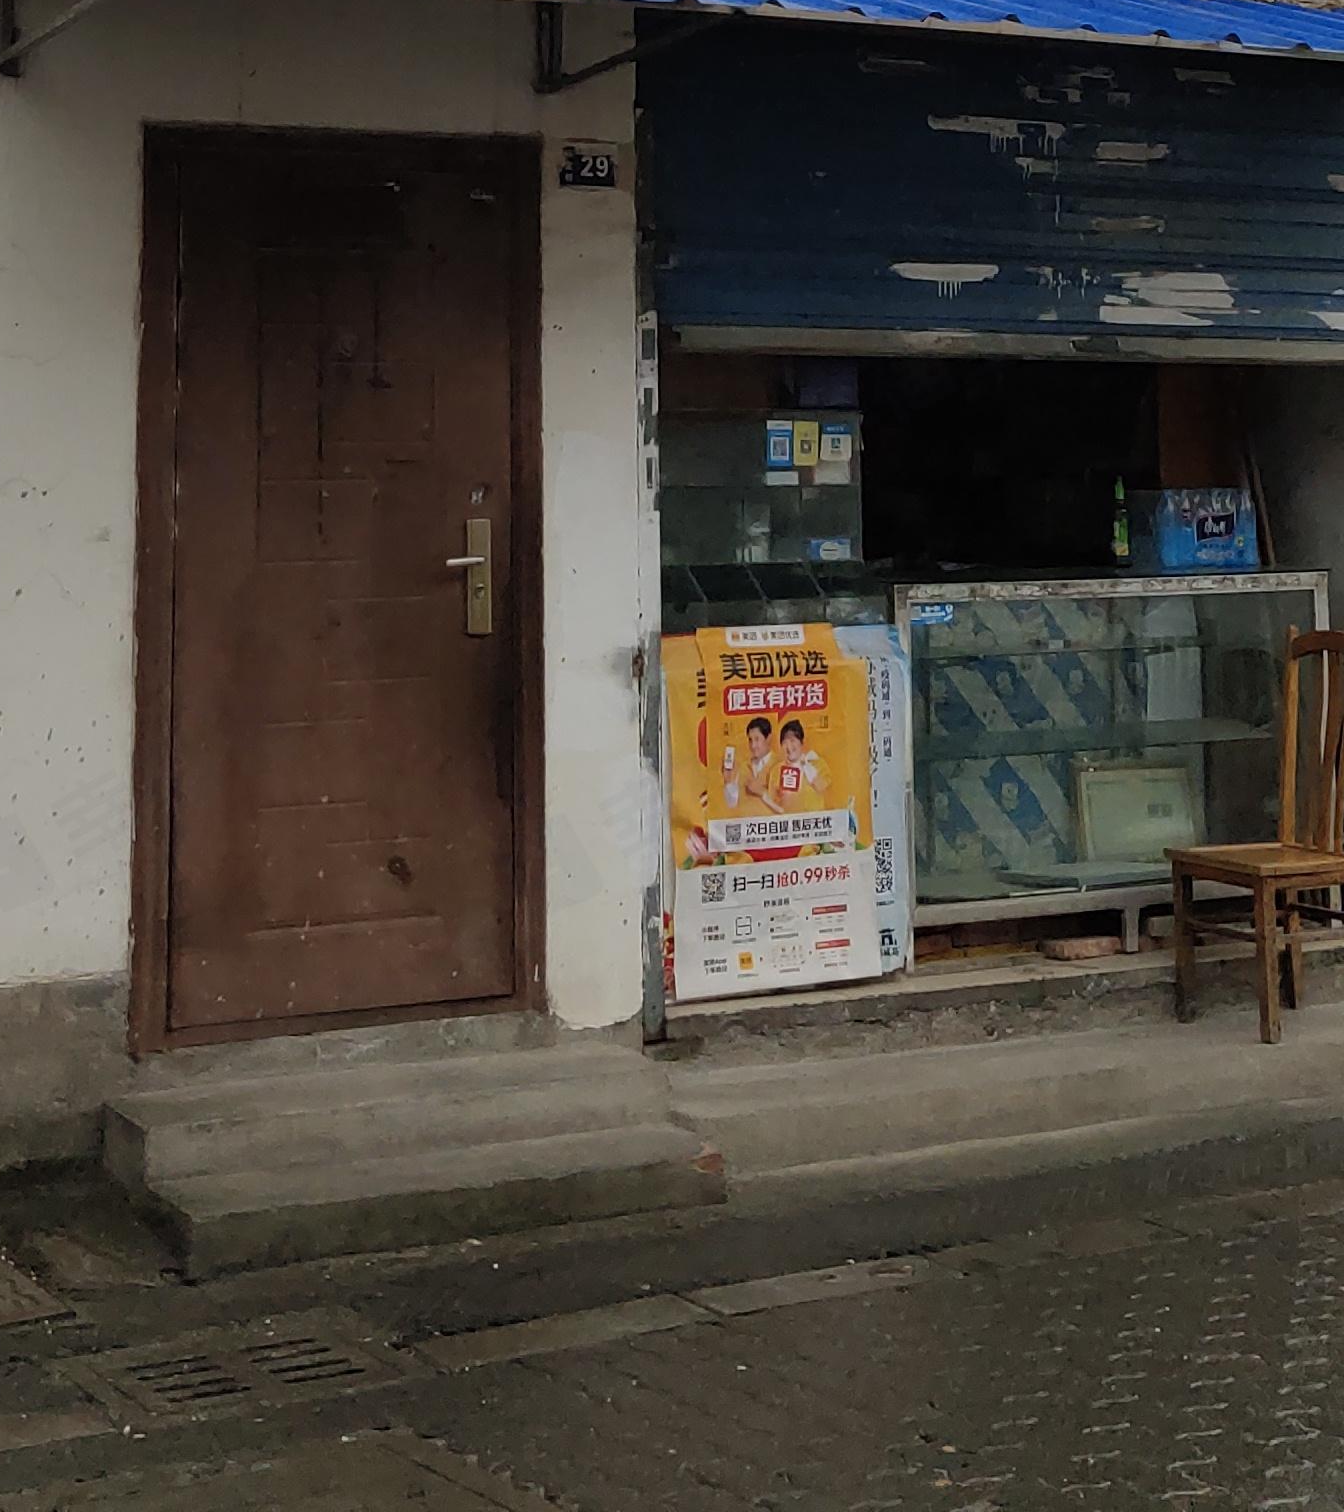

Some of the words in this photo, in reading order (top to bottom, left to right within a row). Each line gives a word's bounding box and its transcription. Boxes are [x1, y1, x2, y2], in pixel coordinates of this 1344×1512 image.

[580, 156, 609, 177] 29
[719, 650, 829, 681] 美团优选
[727, 683, 825, 712] 便宜有好货
[782, 768, 799, 789] 省
[745, 821, 789, 836] 次日自提
